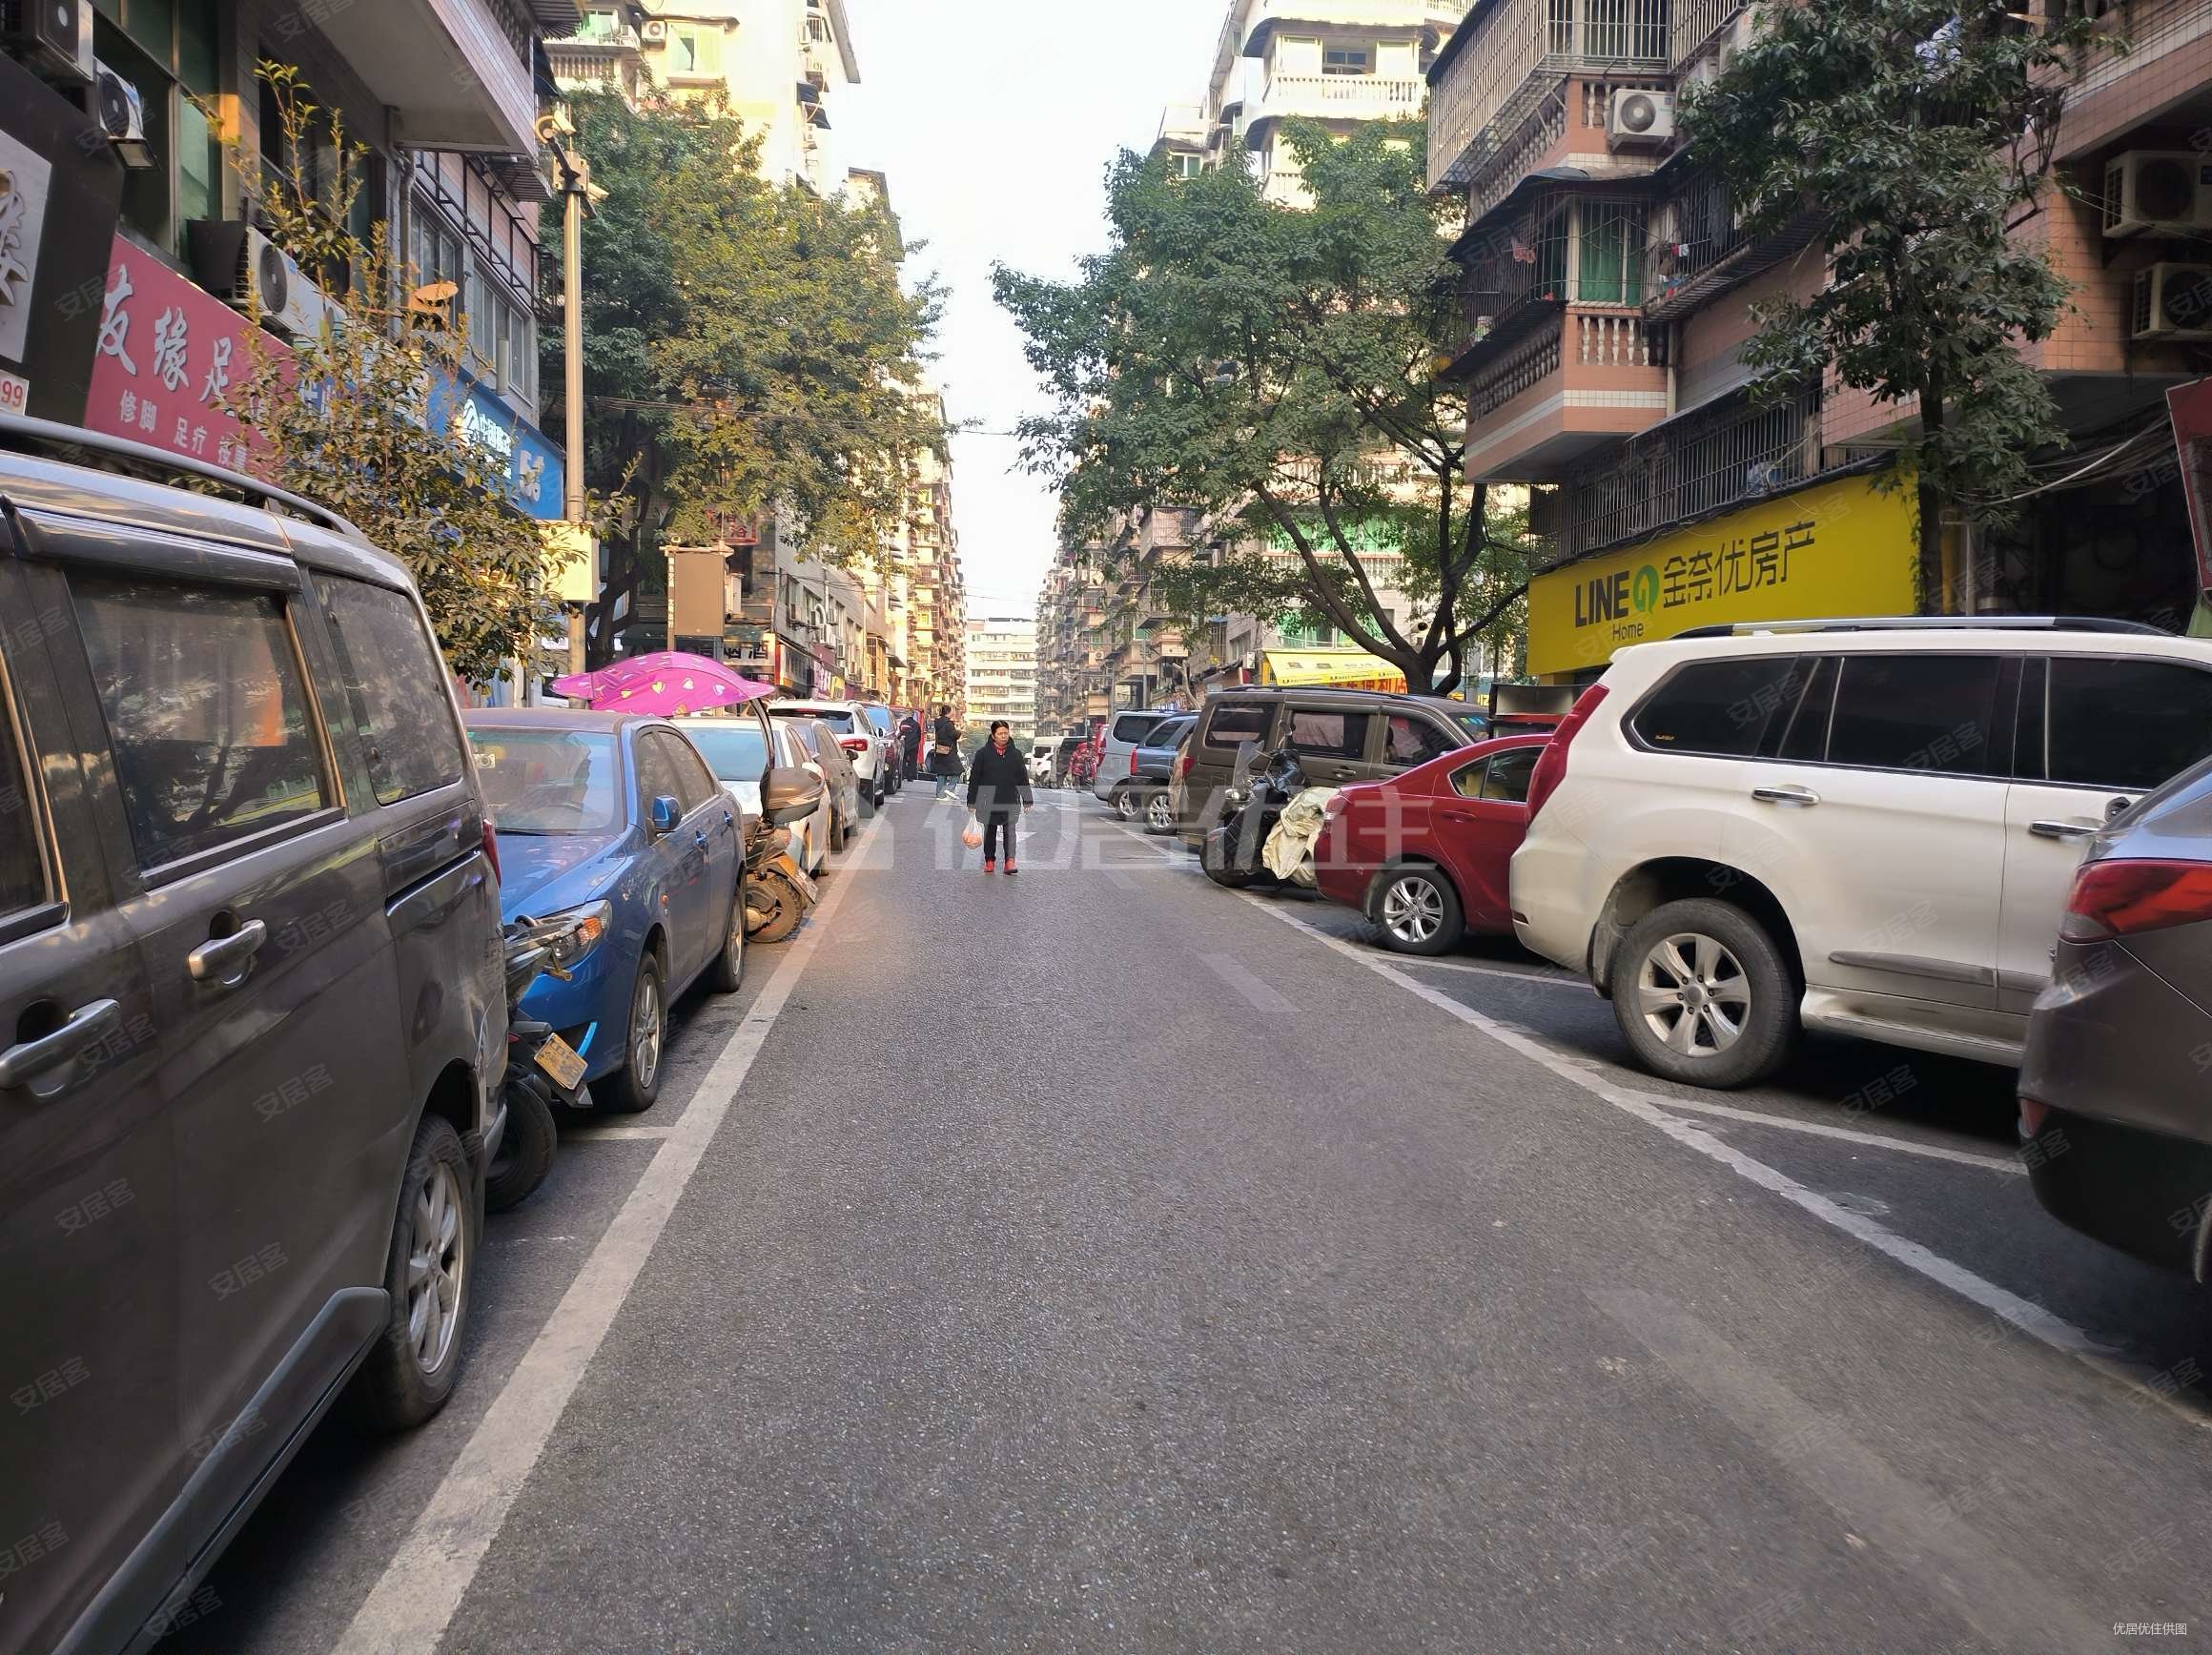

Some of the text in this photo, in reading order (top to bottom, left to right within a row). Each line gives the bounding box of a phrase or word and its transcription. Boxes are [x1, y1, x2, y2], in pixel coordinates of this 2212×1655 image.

[120, 389, 157, 434] 修脚
[173, 417, 208, 455] 足疗
[1663, 521, 1815, 608] 金奈优房产
[1612, 622, 1644, 642] Home
